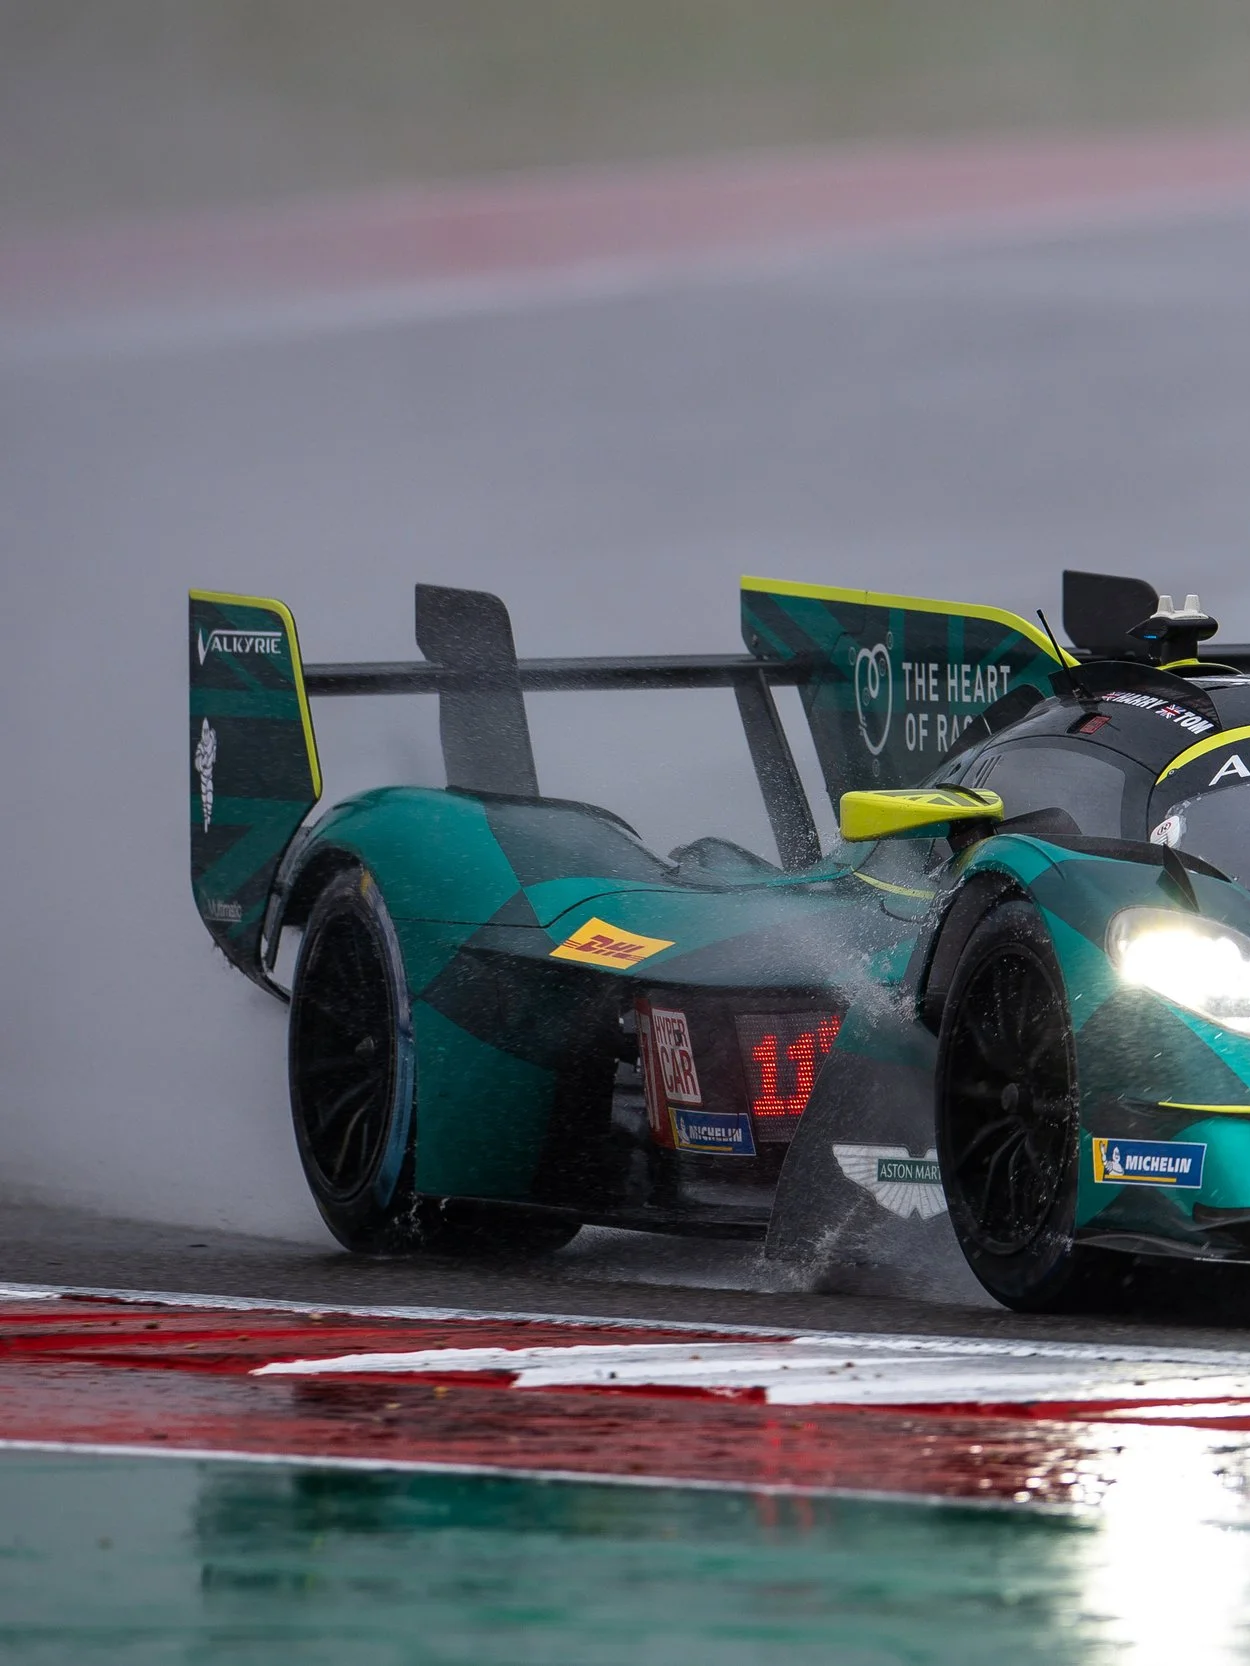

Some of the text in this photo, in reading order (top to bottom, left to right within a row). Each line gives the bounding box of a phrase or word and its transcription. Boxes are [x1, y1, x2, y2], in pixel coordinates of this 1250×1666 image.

[197, 628, 282, 666] VALKYRIE
[902, 662, 1011, 703] THE HEART
[1112, 691, 1215, 735] HARRY TOM
[905, 712, 929, 751] OF
[574, 934, 646, 960] DHL
[654, 1014, 689, 1048] HYPER
[659, 1046, 699, 1096] CAR
[688, 1125, 743, 1143] MICHELIN
[880, 1163, 913, 1179] ASTON
[1125, 1154, 1192, 1174] MICHELIN
